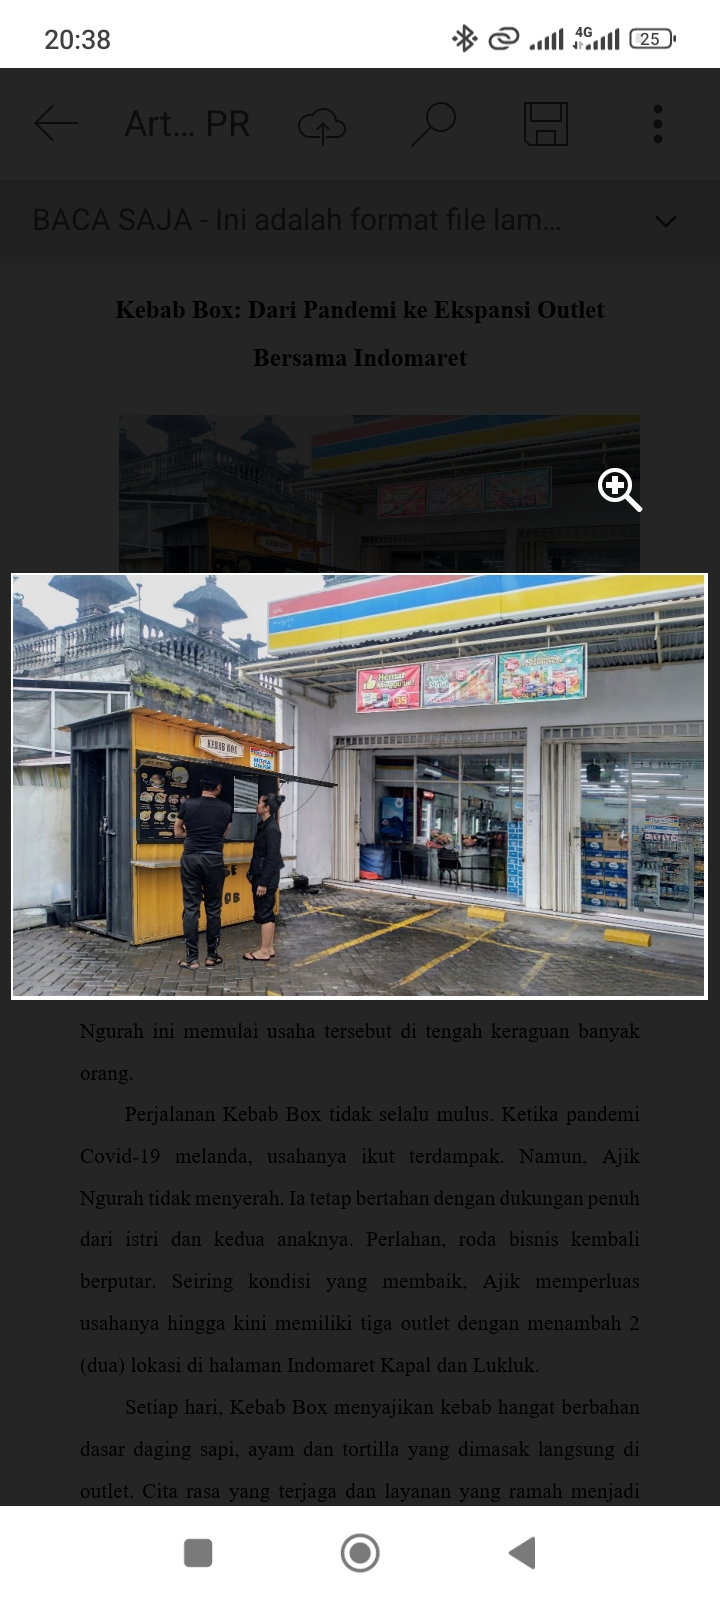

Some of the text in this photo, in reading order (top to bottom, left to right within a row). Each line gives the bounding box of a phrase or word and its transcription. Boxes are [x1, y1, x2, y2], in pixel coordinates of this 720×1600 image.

[45, 29, 110, 49] 20:38
[575, 27, 592, 37] 4G
[641, 33, 659, 45] 25
[208, 110, 249, 136] PR
[34, 208, 110, 230] BACA
[119, 208, 192, 230] SAJA
[218, 208, 245, 230] Ini
[256, 207, 341, 230] adalah
[351, 207, 438, 230] format
[446, 207, 485, 230] file
[116, 301, 605, 323] Kebab Box: Dari Pandemi ke Ekspansi Outlet
[253, 349, 467, 366] Bersama Indomaret
[395, 696, 408, 706] 35
[207, 738, 226, 751] KEBAB
[226, 744, 238, 754] BOX
[79, 1023, 640, 1042] Ngurah ini memulai usaha tersebut di tengah keraguan banyak
[81, 1070, 133, 1084] orang.
[125, 1106, 640, 1125] Perjalanan Kebab Box tidak selalu mulus. Ketika pandemi
[81, 1148, 640, 1167] Covid-19 melanda, usahanya ikut terdampak. Namun, Ajik
[79, 1190, 640, 1209] Ngurah tidak menyerah. Ia tetap bertahan dengan dukungan penuh
[80, 1231, 640, 1250] dari istri dan kedua anaknya. Perlahan, roda bisnis kembali
[80, 1273, 639, 1292] berputar. Seiring kondisi yang membaik, Ajik memperluas
[80, 1315, 639, 1334] usahanya hingga kini memiliki tiga outlet dengan menambah 2
[81, 1357, 539, 1376] (dua) lokasi di halaman Indomaret Kapal dan Lukluk.
[126, 1399, 640, 1418] Setiap hari, Kebab Box menyajikan kebab hangat berbahan
[81, 1441, 640, 1460] dasar daging sapi, ayam dan tortilla yang dimasak langsung di
[80, 1483, 640, 1502] outlet. Cita rasa yang terjaga dan layanan yang ramah menjadi
